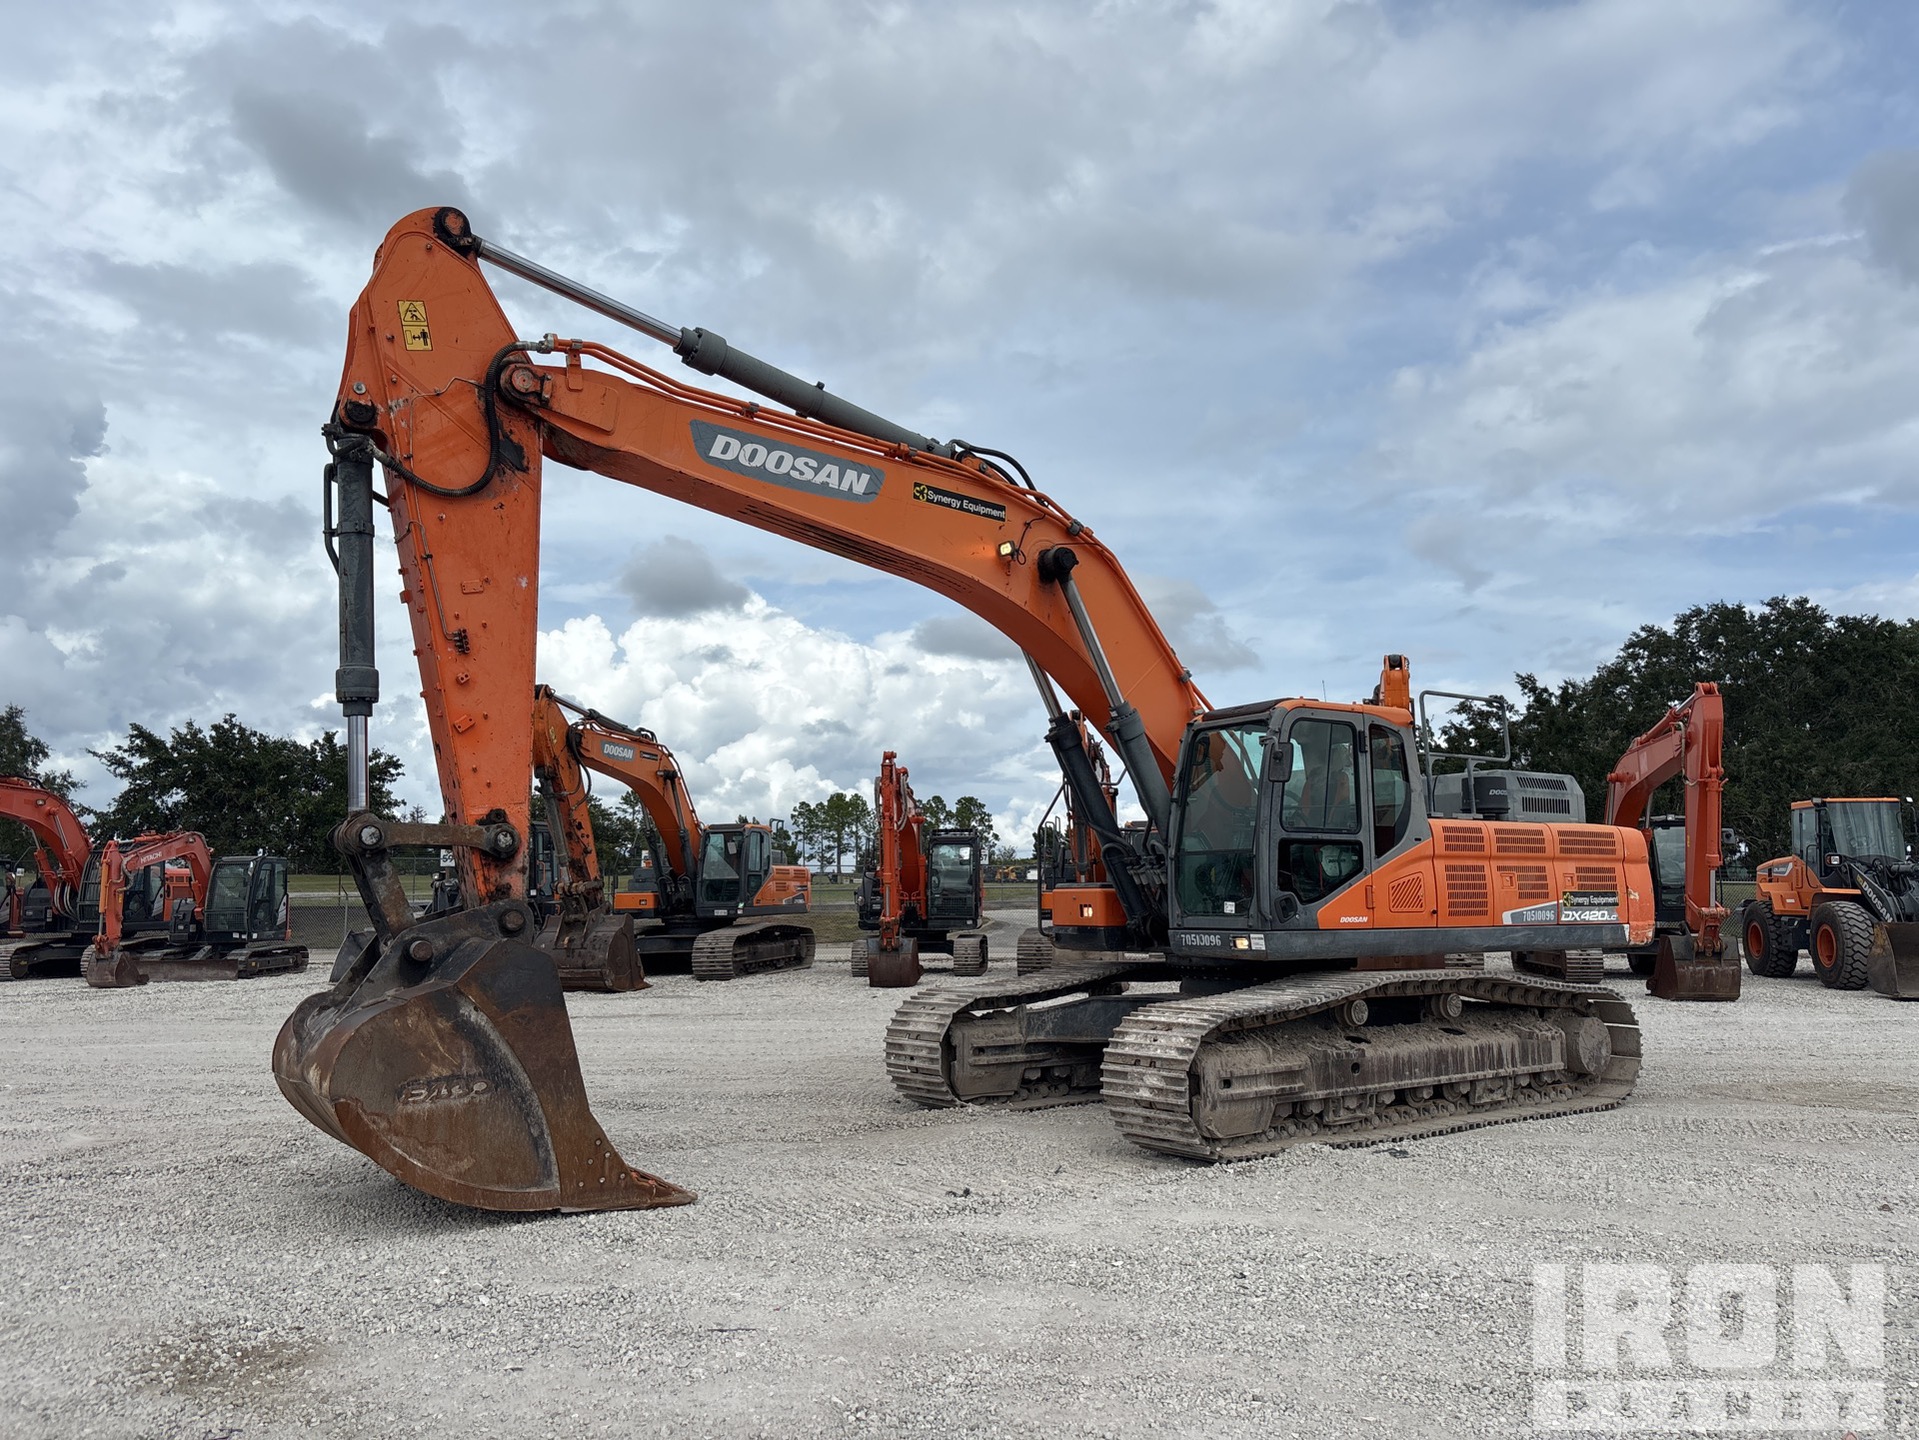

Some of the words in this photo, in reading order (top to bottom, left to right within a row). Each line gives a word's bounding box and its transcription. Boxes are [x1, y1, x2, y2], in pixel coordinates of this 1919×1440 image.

[708, 434, 870, 495] DOOSAN
[927, 490, 961, 508] Synergy
[962, 499, 1006, 519] Equipment
[603, 744, 634, 759] DOOSAN
[1570, 895, 1590, 906] Synergy
[1591, 895, 1619, 906] Equipment
[1339, 915, 1369, 923] DOOSAN
